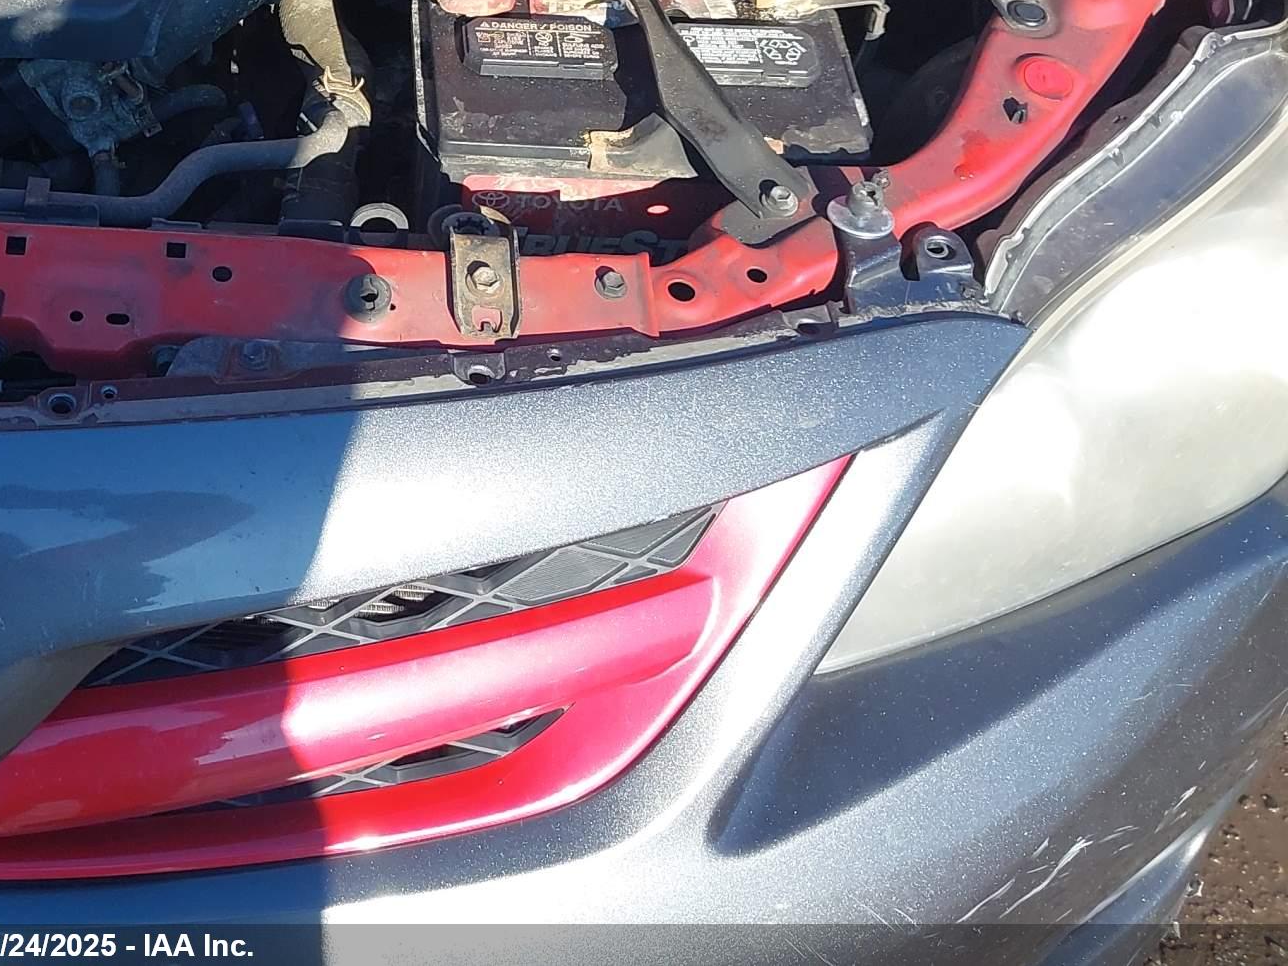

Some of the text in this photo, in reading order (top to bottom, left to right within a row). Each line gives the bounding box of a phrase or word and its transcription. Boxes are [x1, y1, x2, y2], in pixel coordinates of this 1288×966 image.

[491, 22, 539, 30] DANGER
[549, 23, 592, 31] POISON
[515, 195, 624, 212] TOYOTA
